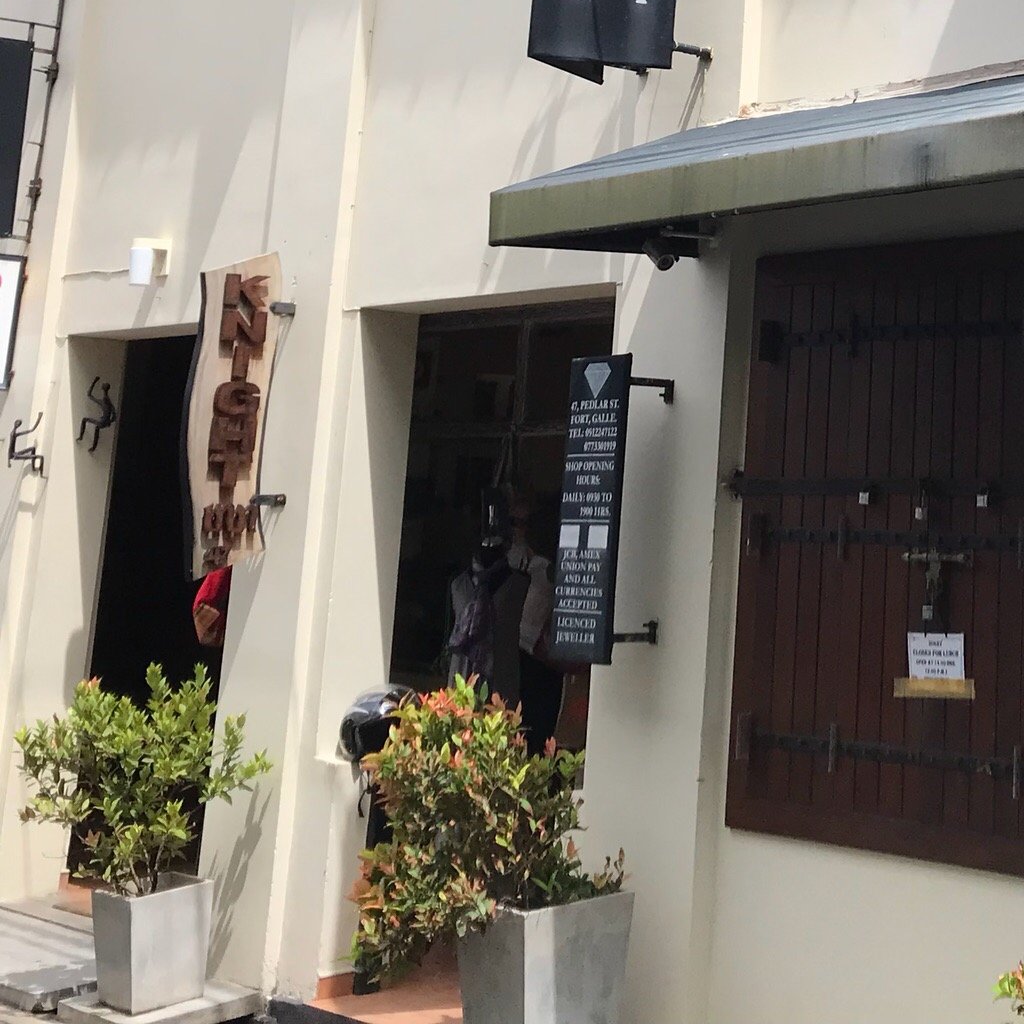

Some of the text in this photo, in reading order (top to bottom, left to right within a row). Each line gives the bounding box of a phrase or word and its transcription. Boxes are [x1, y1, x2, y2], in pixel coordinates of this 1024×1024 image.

[580, 399, 609, 410] PEDLAR
[609, 398, 620, 409] ST.
[570, 414, 591, 426] FORT,
[568, 428, 584, 439] TEL:
[565, 460, 615, 472] SHOP OPENING
[562, 492, 586, 503] DAILY:
[601, 492, 612, 502] TO
[579, 550, 600, 560] AMEX
[560, 561, 602, 572] UNION PAY
[564, 573, 596, 584] AND ALL
[555, 586, 603, 597] CURRENCIES
[558, 598, 598, 610] ACCEPTED
[557, 616, 596, 629] LICENCED
[555, 631, 595, 644] JEWELLER
